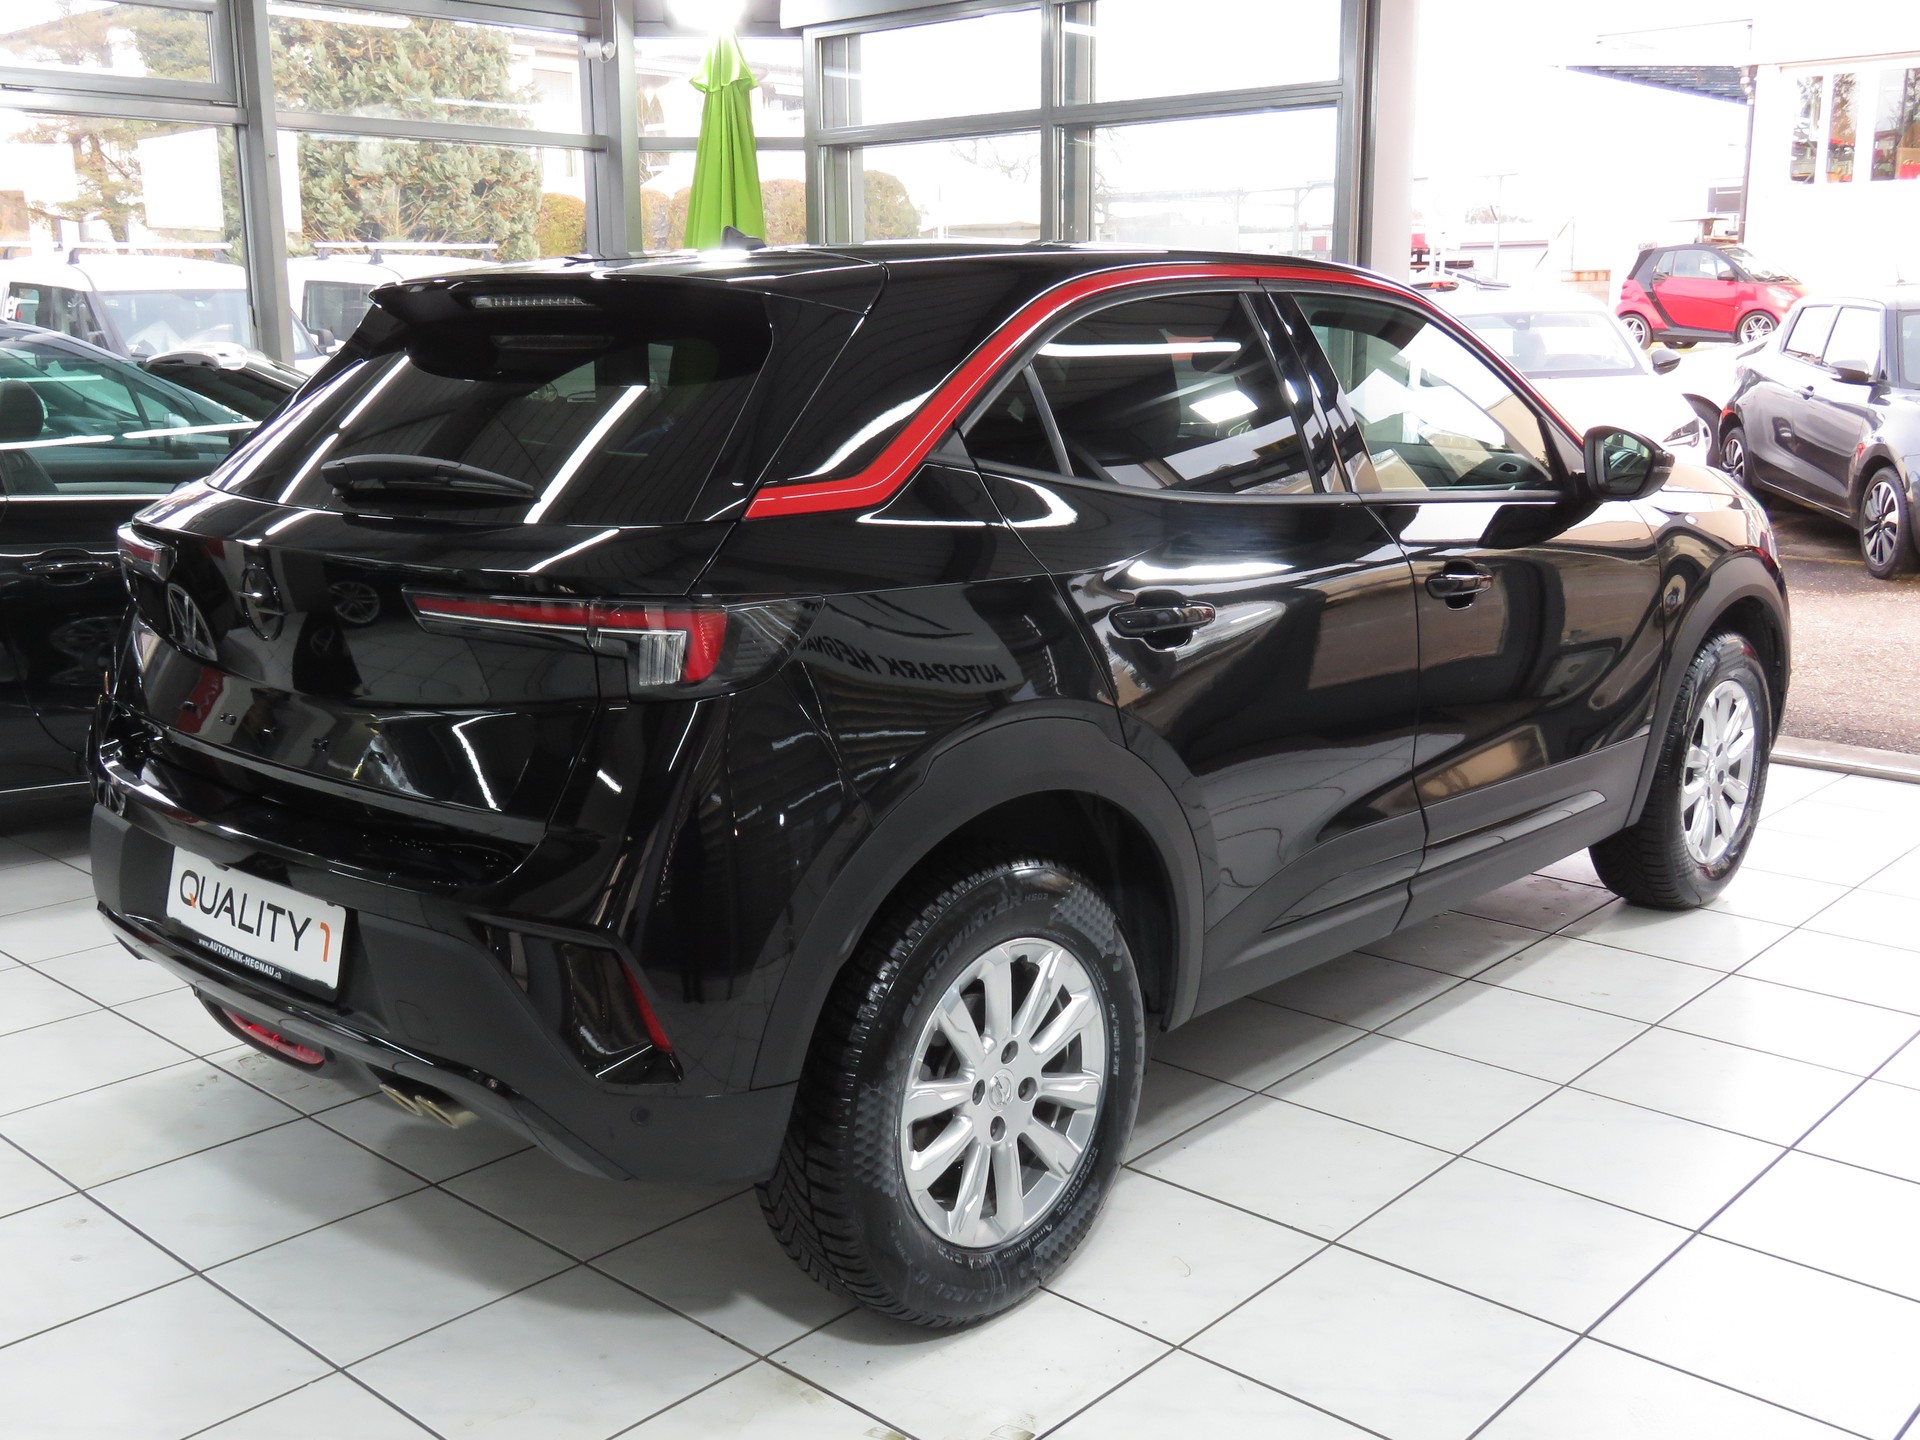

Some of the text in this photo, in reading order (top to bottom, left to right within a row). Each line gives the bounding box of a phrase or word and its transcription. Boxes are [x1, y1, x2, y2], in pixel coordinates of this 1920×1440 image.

[179, 869, 331, 962] QUALITY 1
[198, 938, 282, 979] www.AUTOPARK-HEGNAU.ch
[902, 888, 1023, 1028] EUROWINTER
